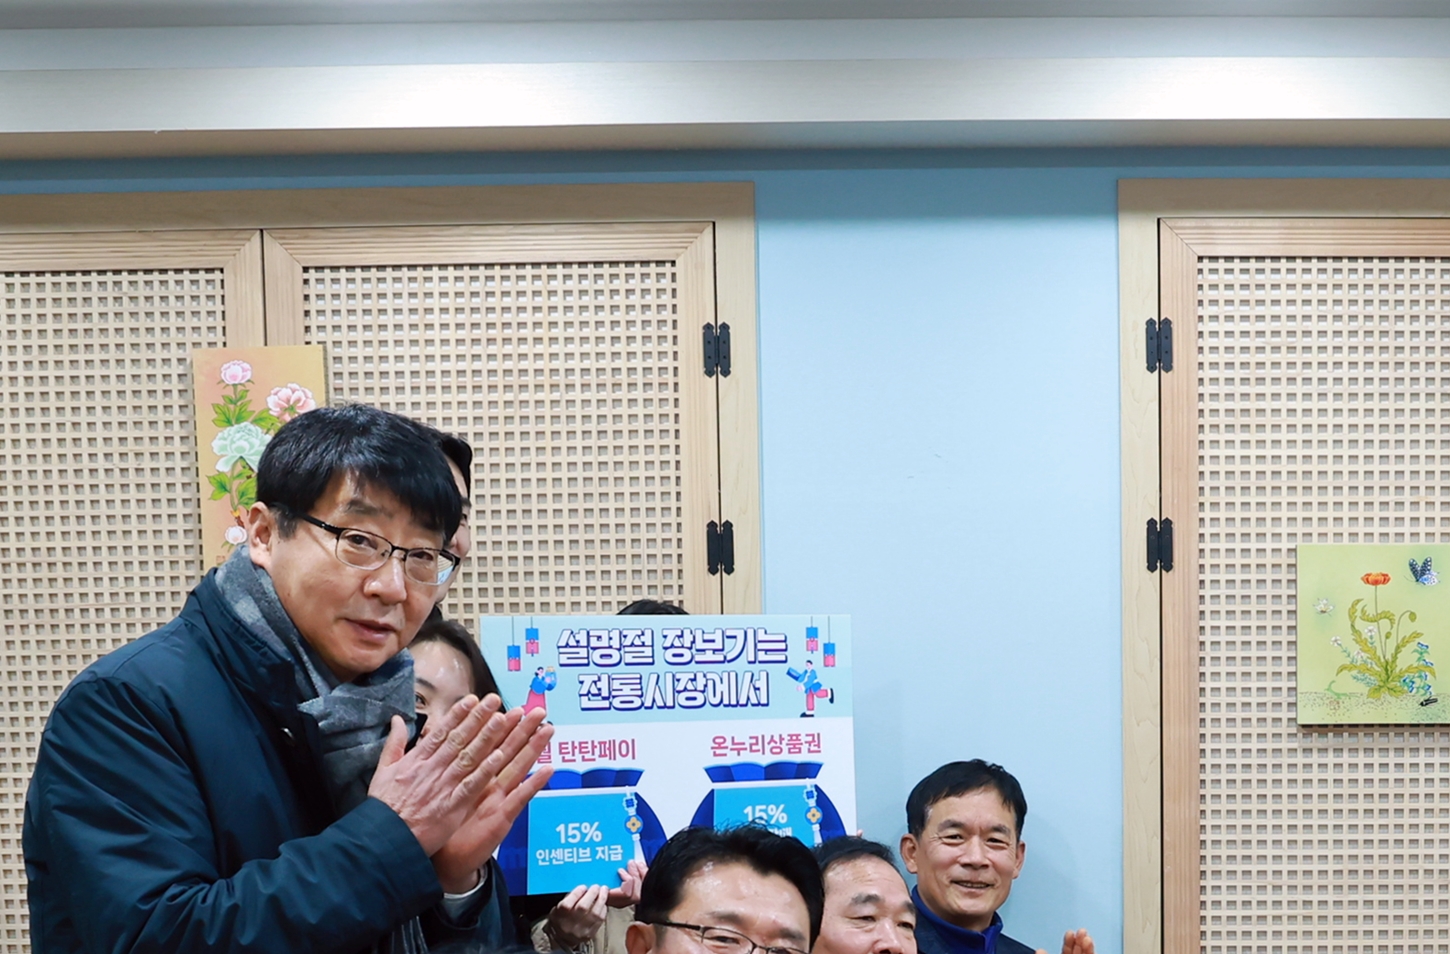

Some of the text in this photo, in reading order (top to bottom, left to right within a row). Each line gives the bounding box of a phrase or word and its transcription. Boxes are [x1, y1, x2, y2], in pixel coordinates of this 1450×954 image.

[556, 626, 789, 667] 설명절 장보기는
[577, 669, 770, 711] 전통시장에서
[558, 738, 636, 763] 탄탄페이
[710, 733, 822, 758] 온누리상품권
[555, 821, 603, 844] 15%
[535, 844, 624, 866] 인센티브 지급
